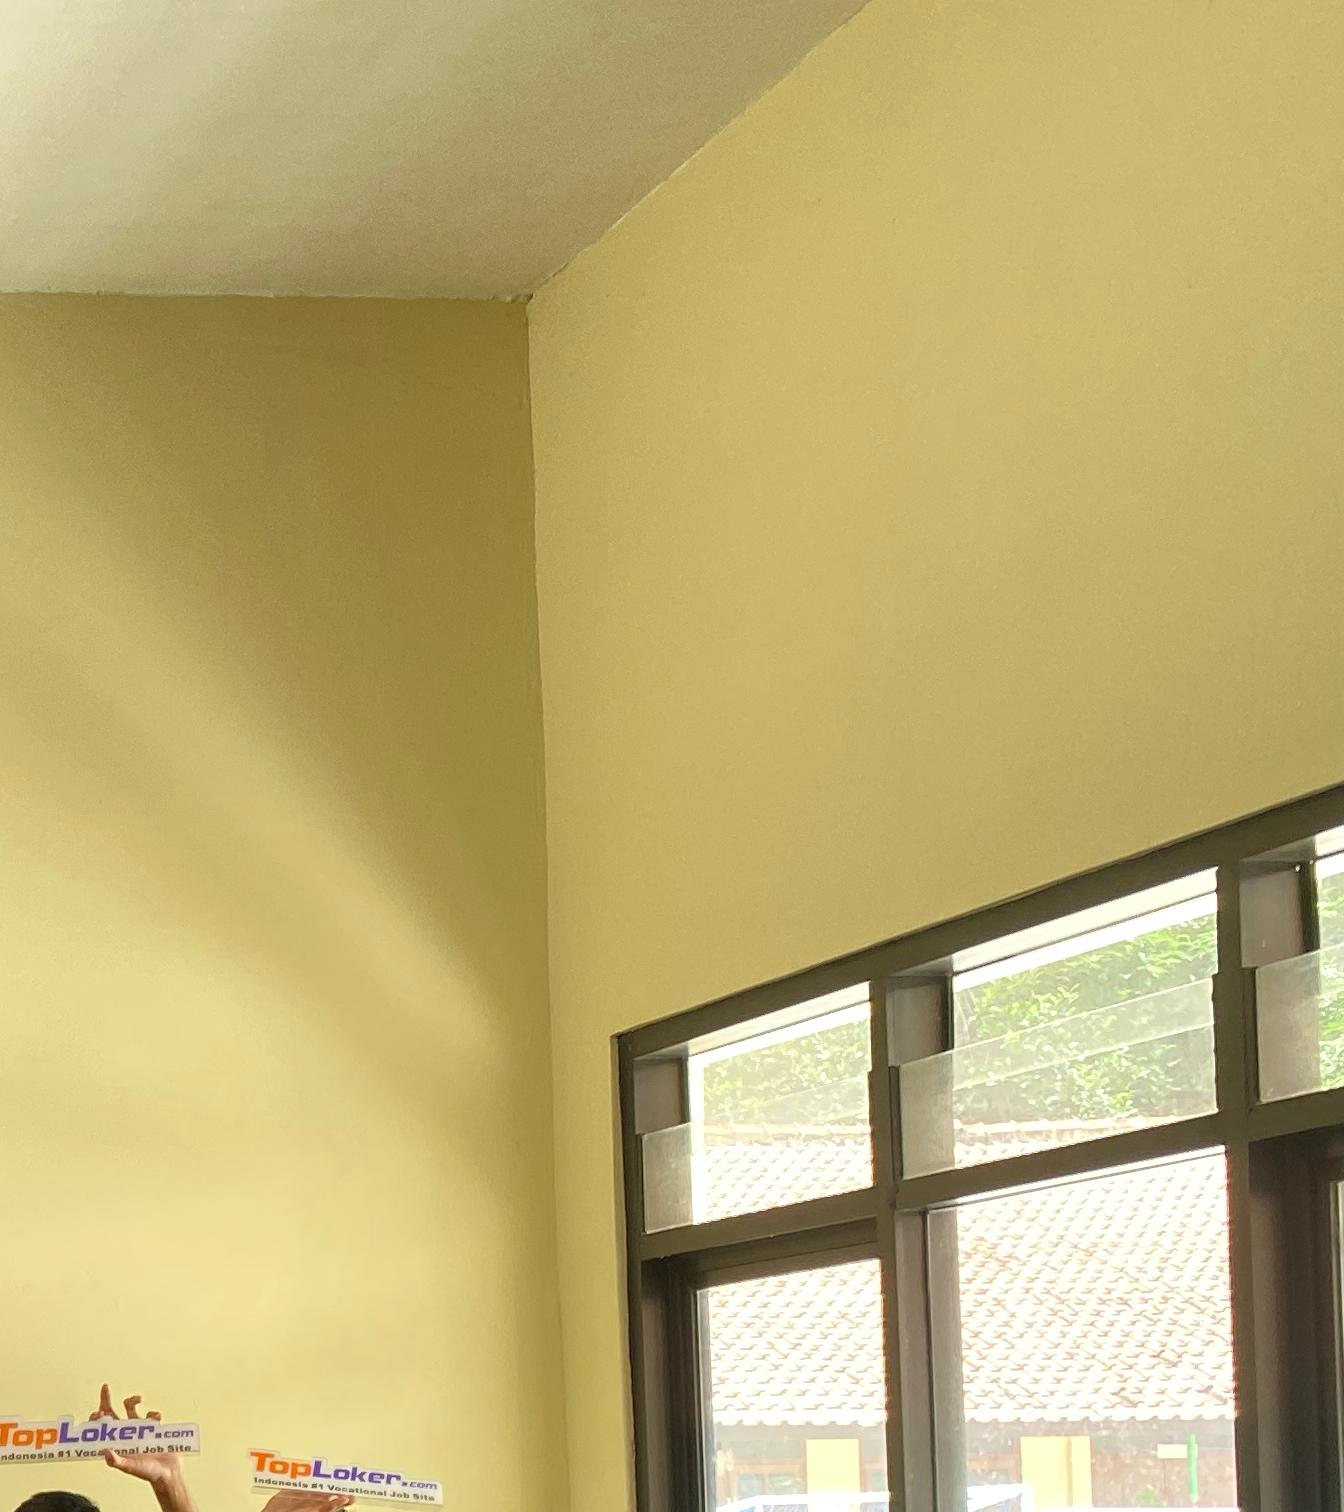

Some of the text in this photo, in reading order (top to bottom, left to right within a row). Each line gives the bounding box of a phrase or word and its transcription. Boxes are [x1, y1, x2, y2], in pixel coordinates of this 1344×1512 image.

[75, 1446, 140, 1457] Vocaonal
[142, 1446, 164, 1454] Job
[167, 1444, 192, 1453] Site
[250, 1452, 438, 1490] TopLoker.com
[254, 1477, 309, 1489] Indonesia
[328, 1485, 387, 1497] Vocational
[412, 1493, 435, 1502] Site
